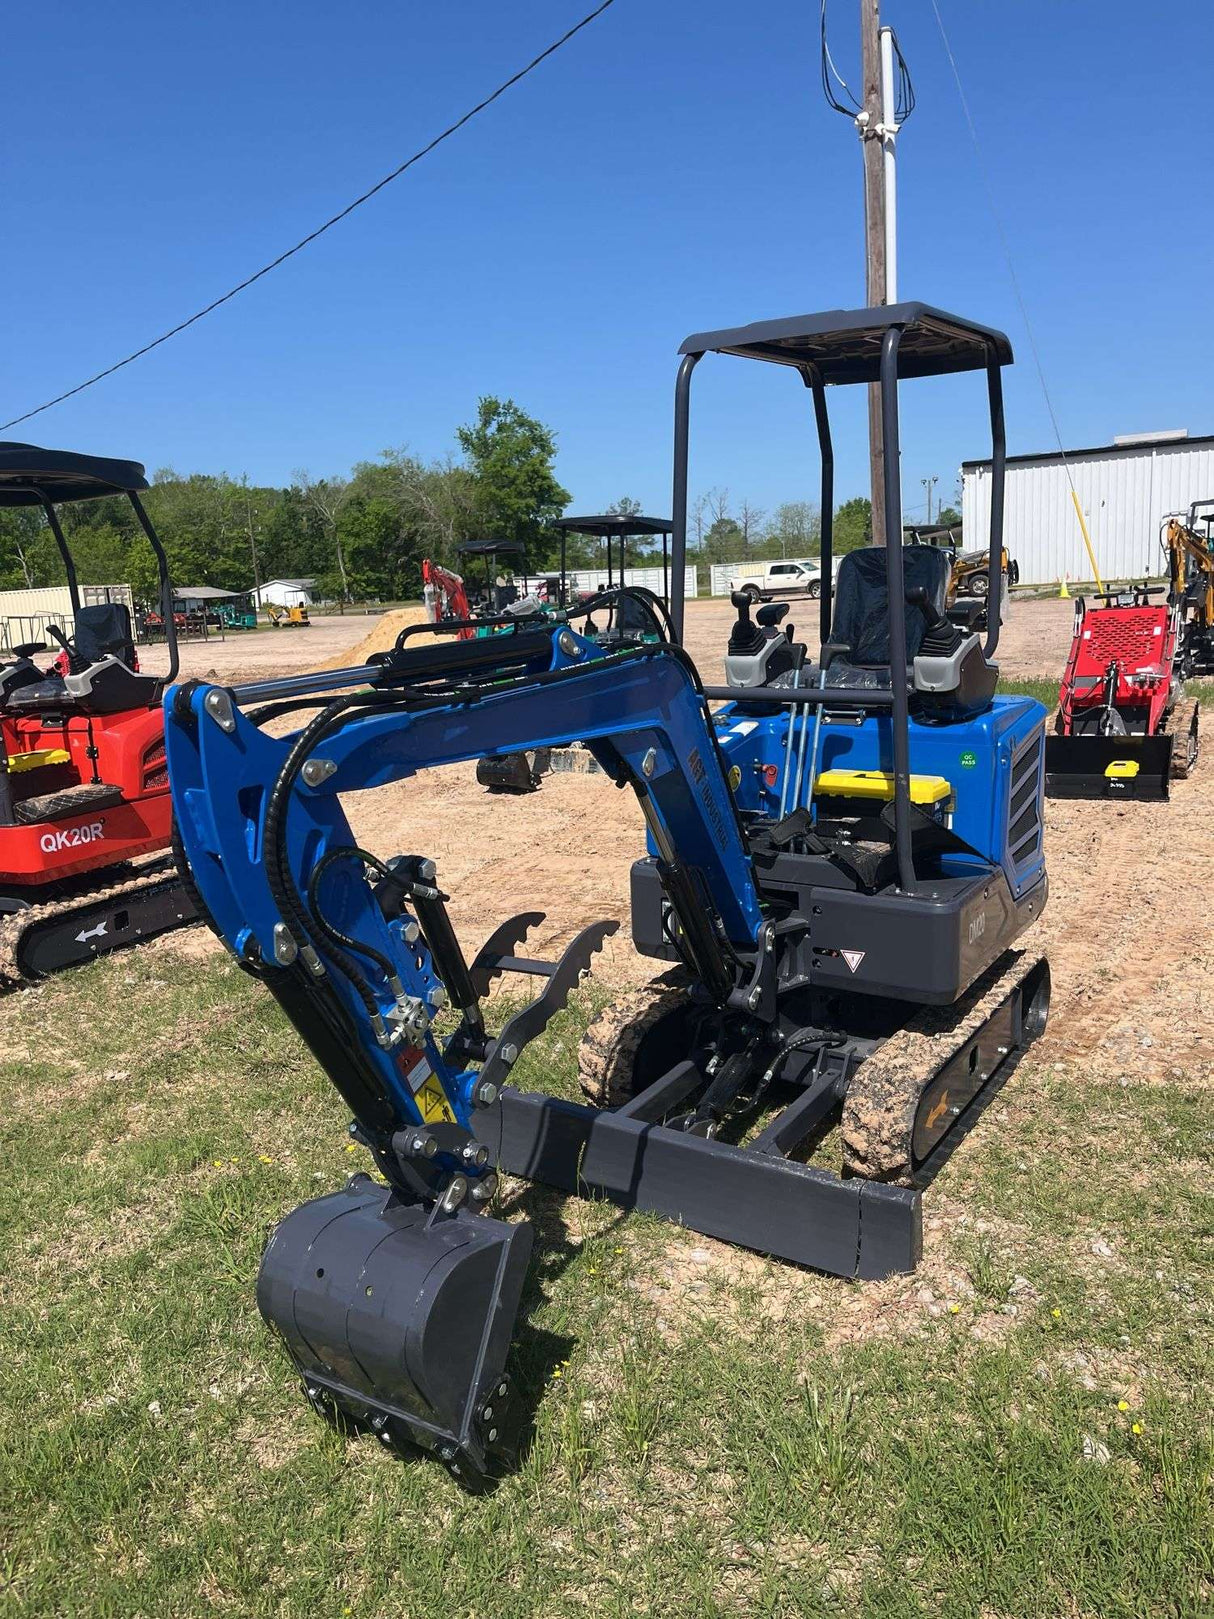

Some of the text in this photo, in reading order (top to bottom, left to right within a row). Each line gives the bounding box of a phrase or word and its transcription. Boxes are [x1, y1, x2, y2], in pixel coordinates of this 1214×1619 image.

[687, 746, 729, 853] AGT INDUSTRIAL
[40, 822, 105, 853] QK20R
